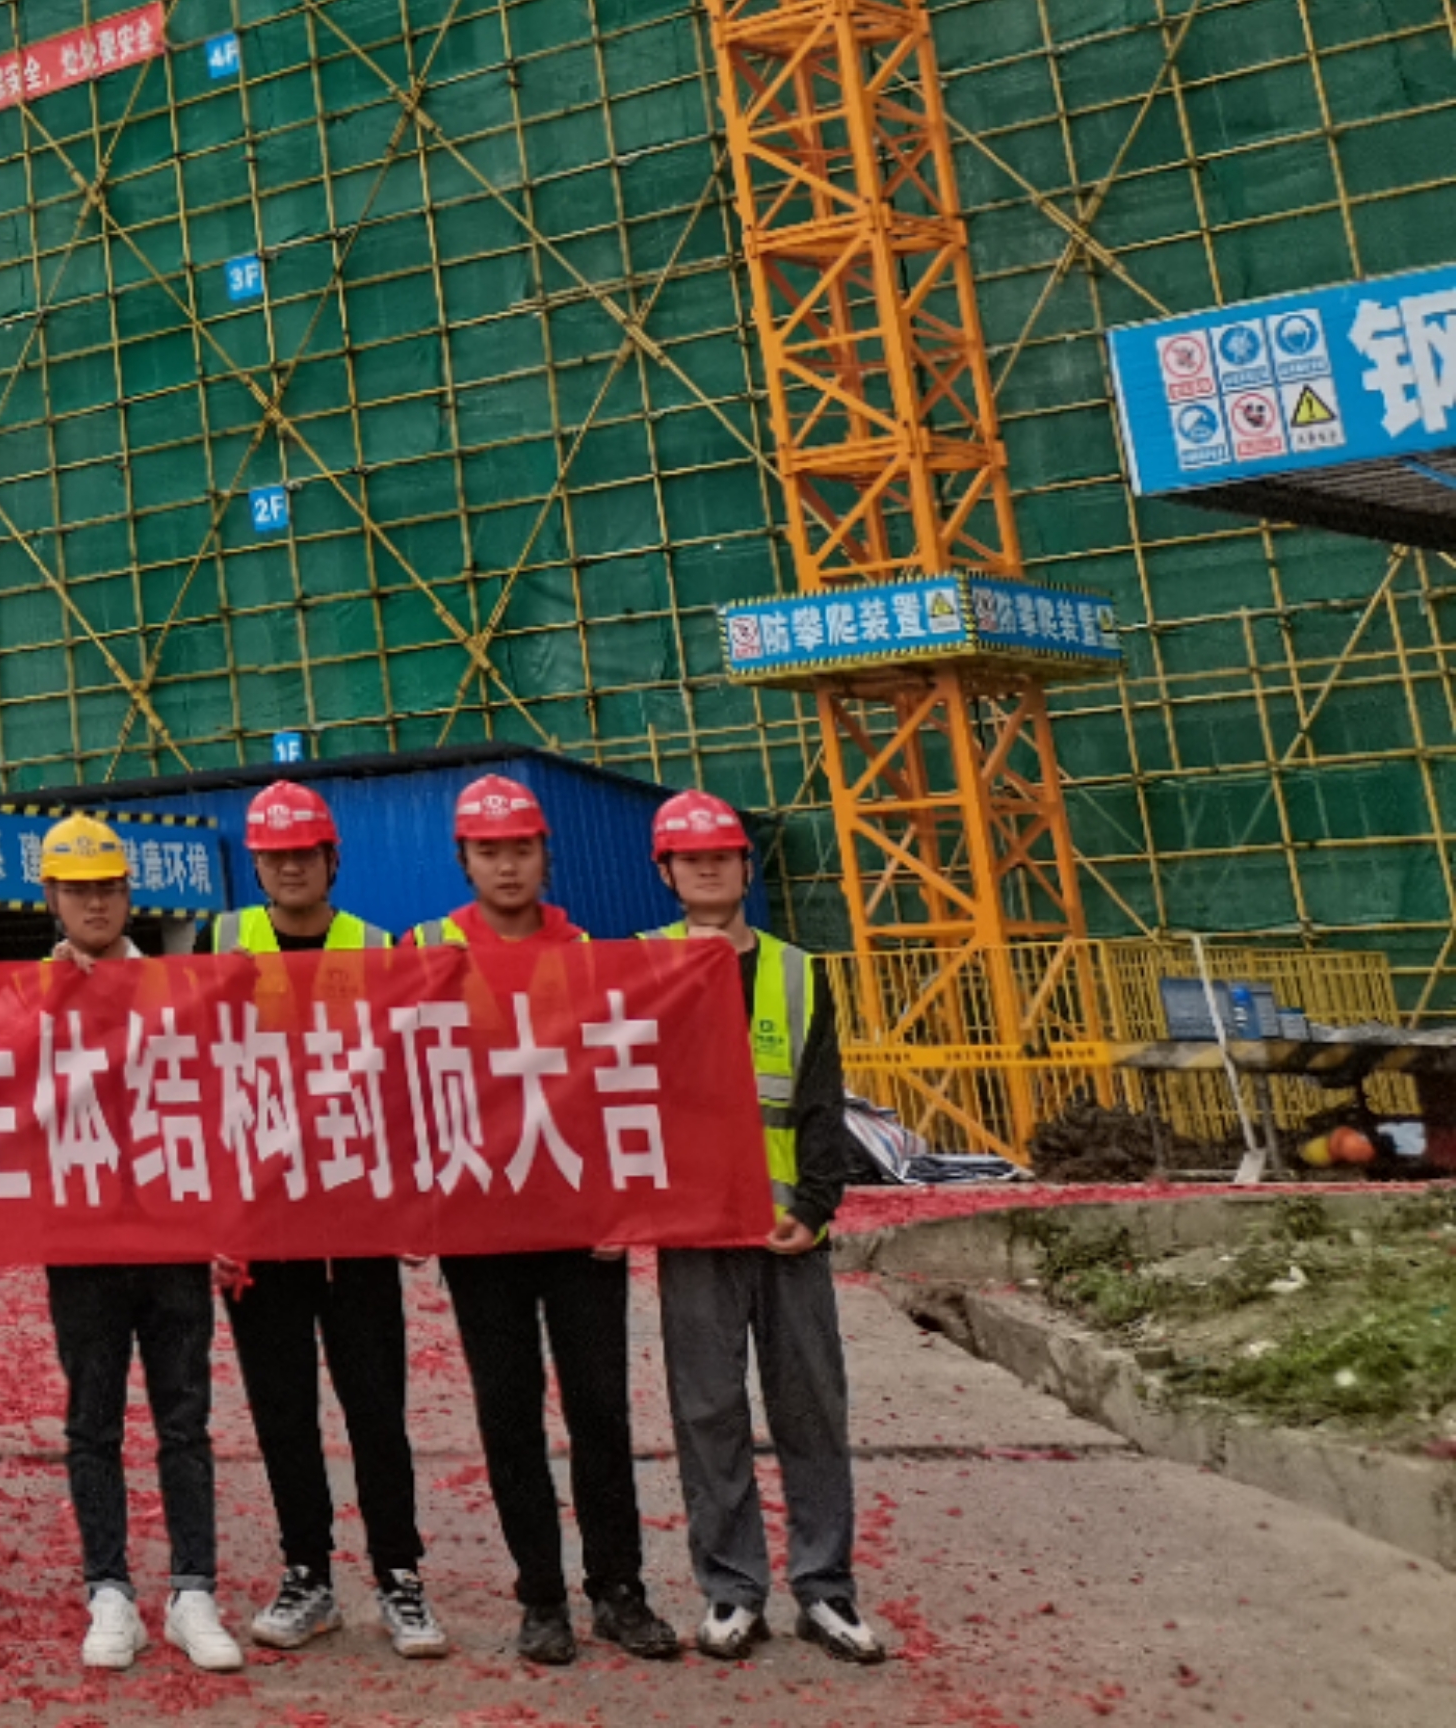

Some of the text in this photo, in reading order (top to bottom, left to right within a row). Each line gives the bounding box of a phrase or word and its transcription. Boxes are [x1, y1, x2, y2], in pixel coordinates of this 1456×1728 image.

[209, 41, 239, 67] 4F
[229, 264, 259, 291] 3F
[254, 495, 284, 524] 2F
[761, 592, 927, 655] 防攀爬装置
[276, 739, 300, 762] 1F
